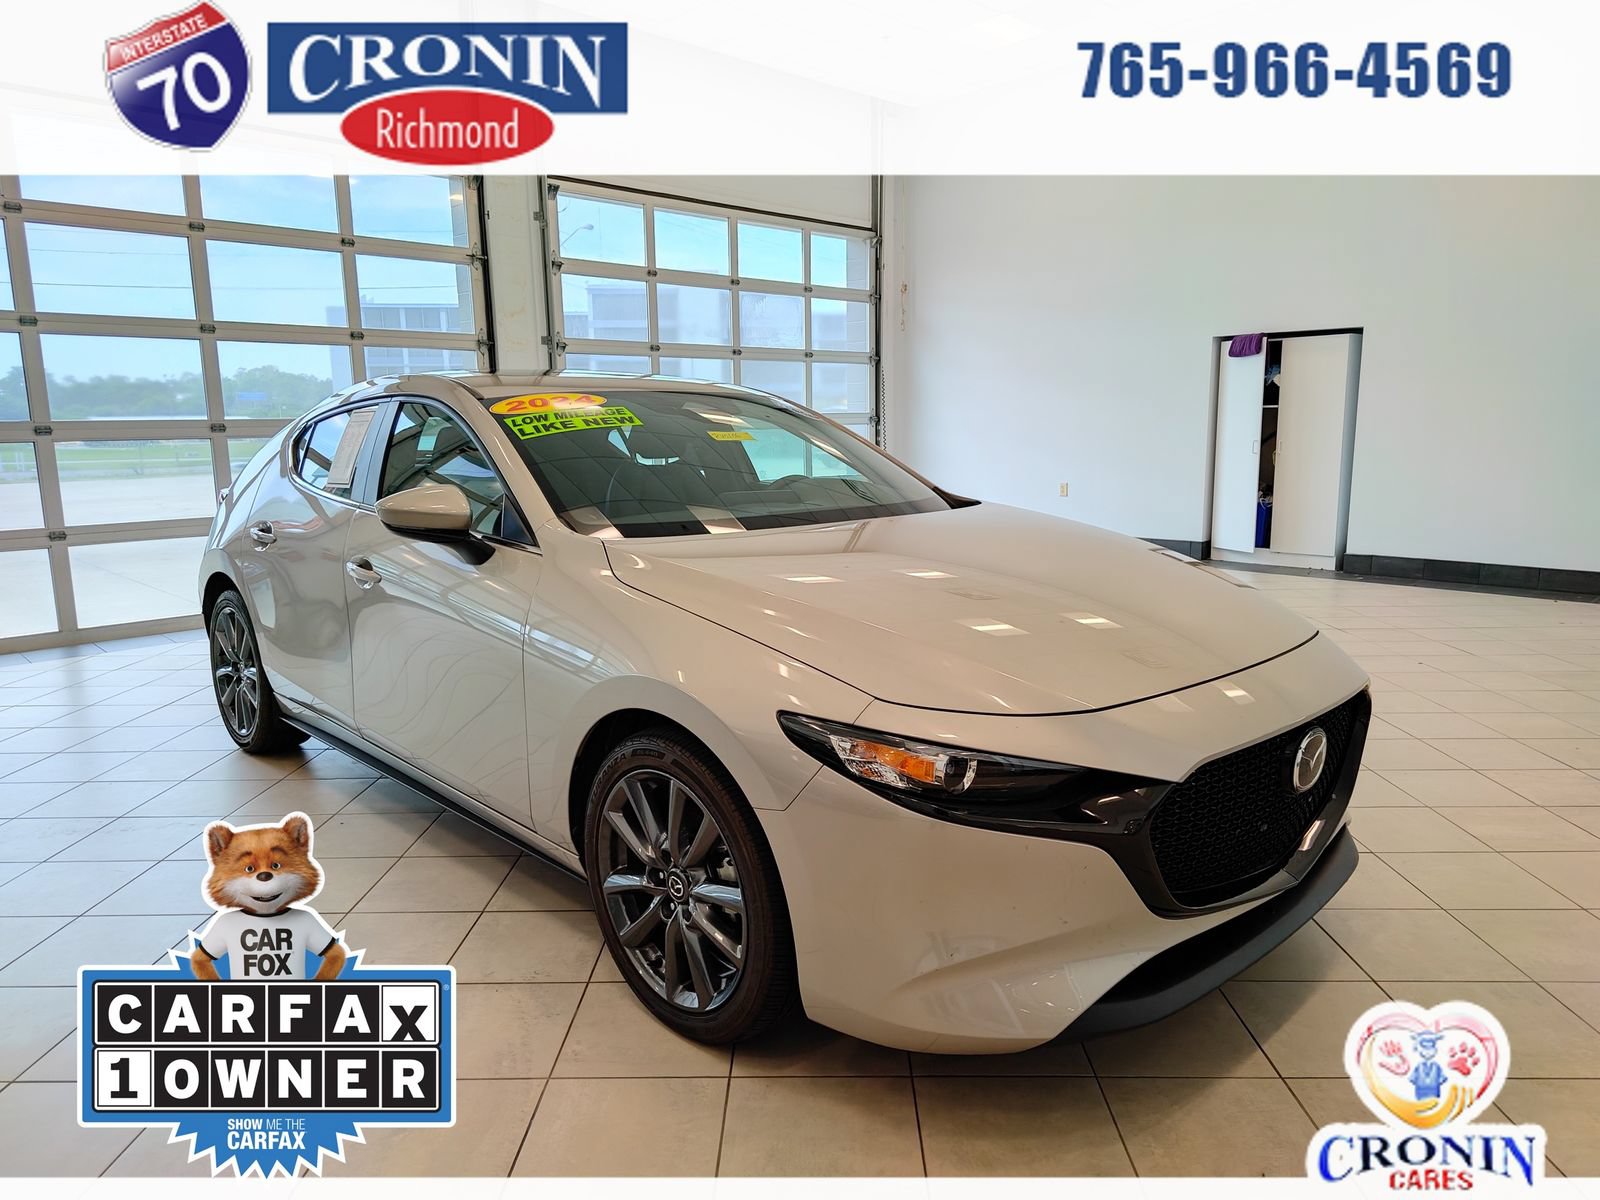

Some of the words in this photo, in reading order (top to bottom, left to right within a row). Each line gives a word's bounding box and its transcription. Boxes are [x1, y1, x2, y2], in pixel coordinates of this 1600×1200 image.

[504, 395, 597, 413] 2024
[511, 413, 549, 428] LOW
[555, 408, 628, 421] MILEAGE
[516, 420, 577, 438] LIKE
[583, 416, 635, 427] NEW
